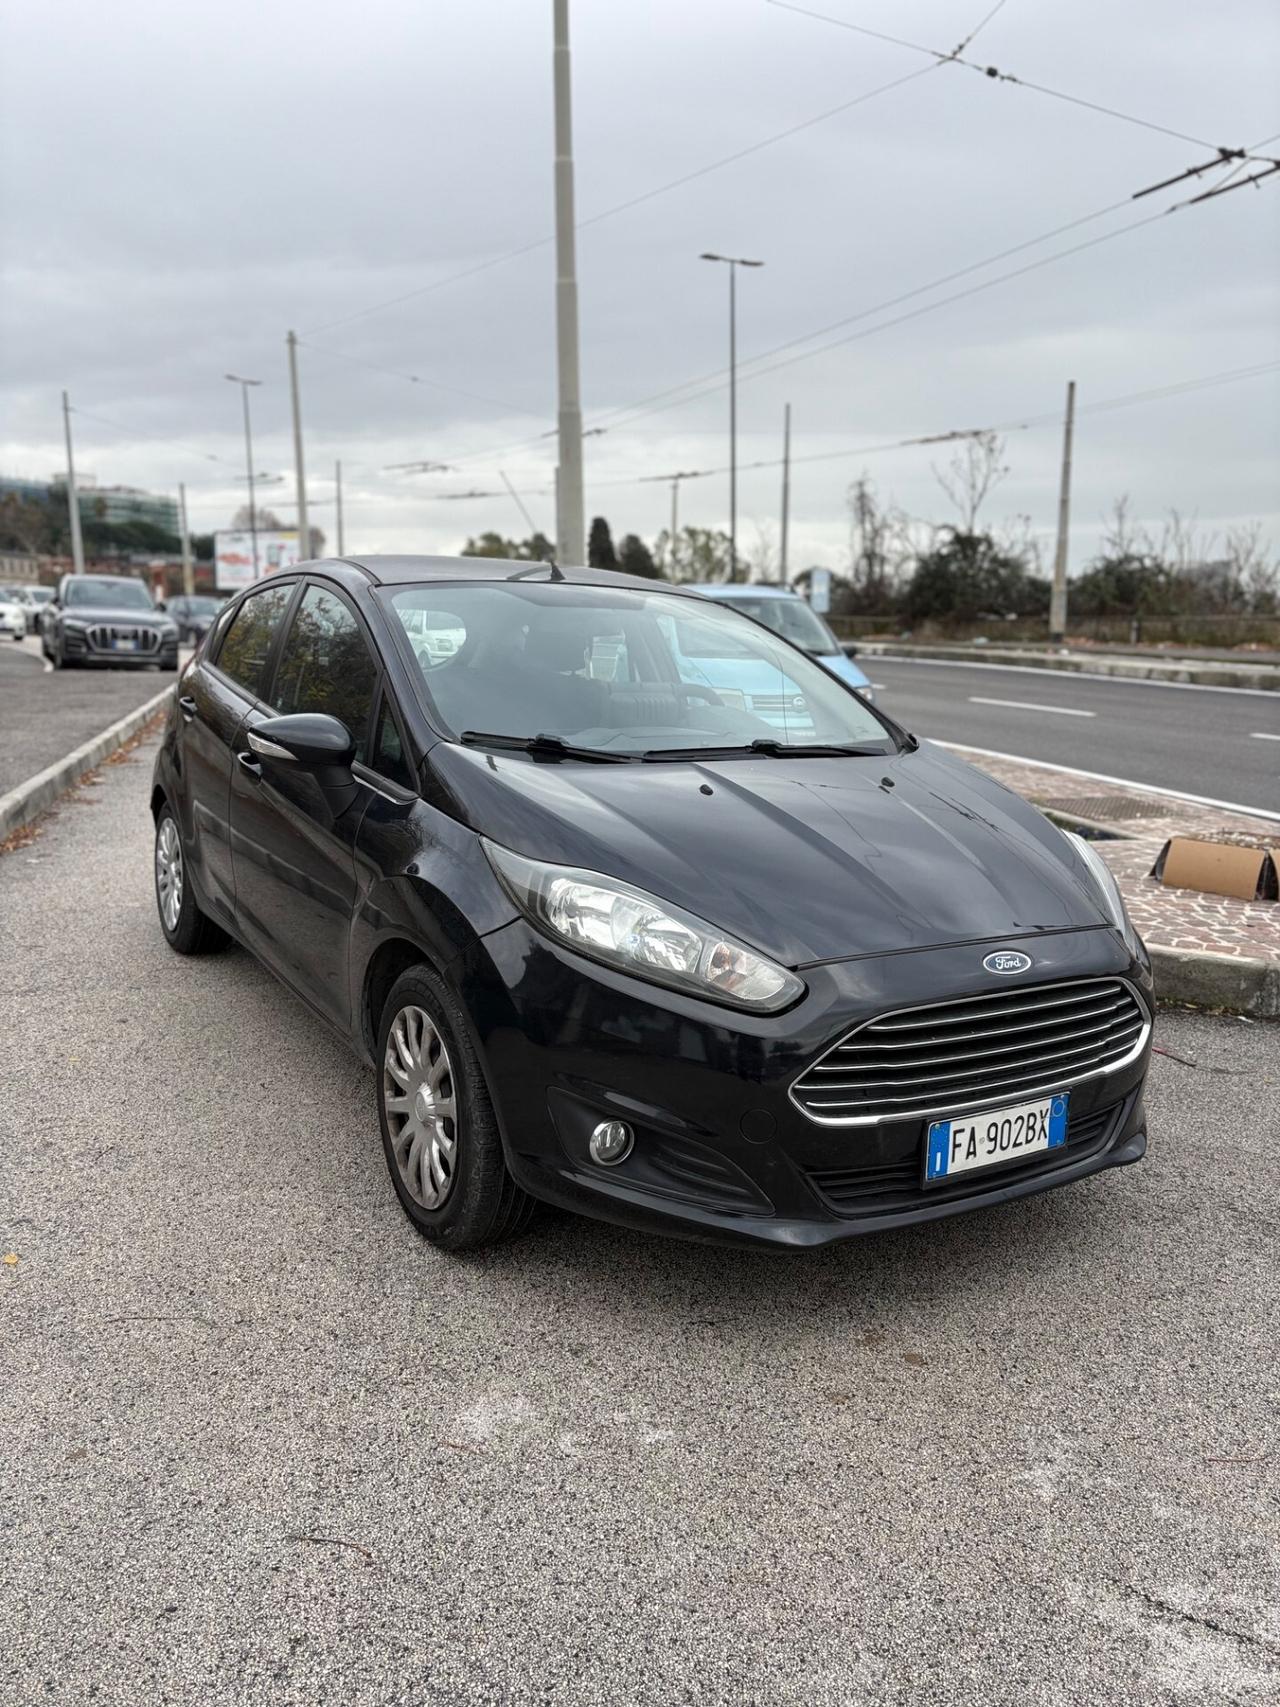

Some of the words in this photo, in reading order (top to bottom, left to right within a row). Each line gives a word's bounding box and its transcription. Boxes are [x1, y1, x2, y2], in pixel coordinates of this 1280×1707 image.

[995, 955, 1021, 970] Ford
[951, 1126, 977, 1163] FA
[986, 1108, 1049, 1154] 902BX
[935, 1151, 942, 1172] I
